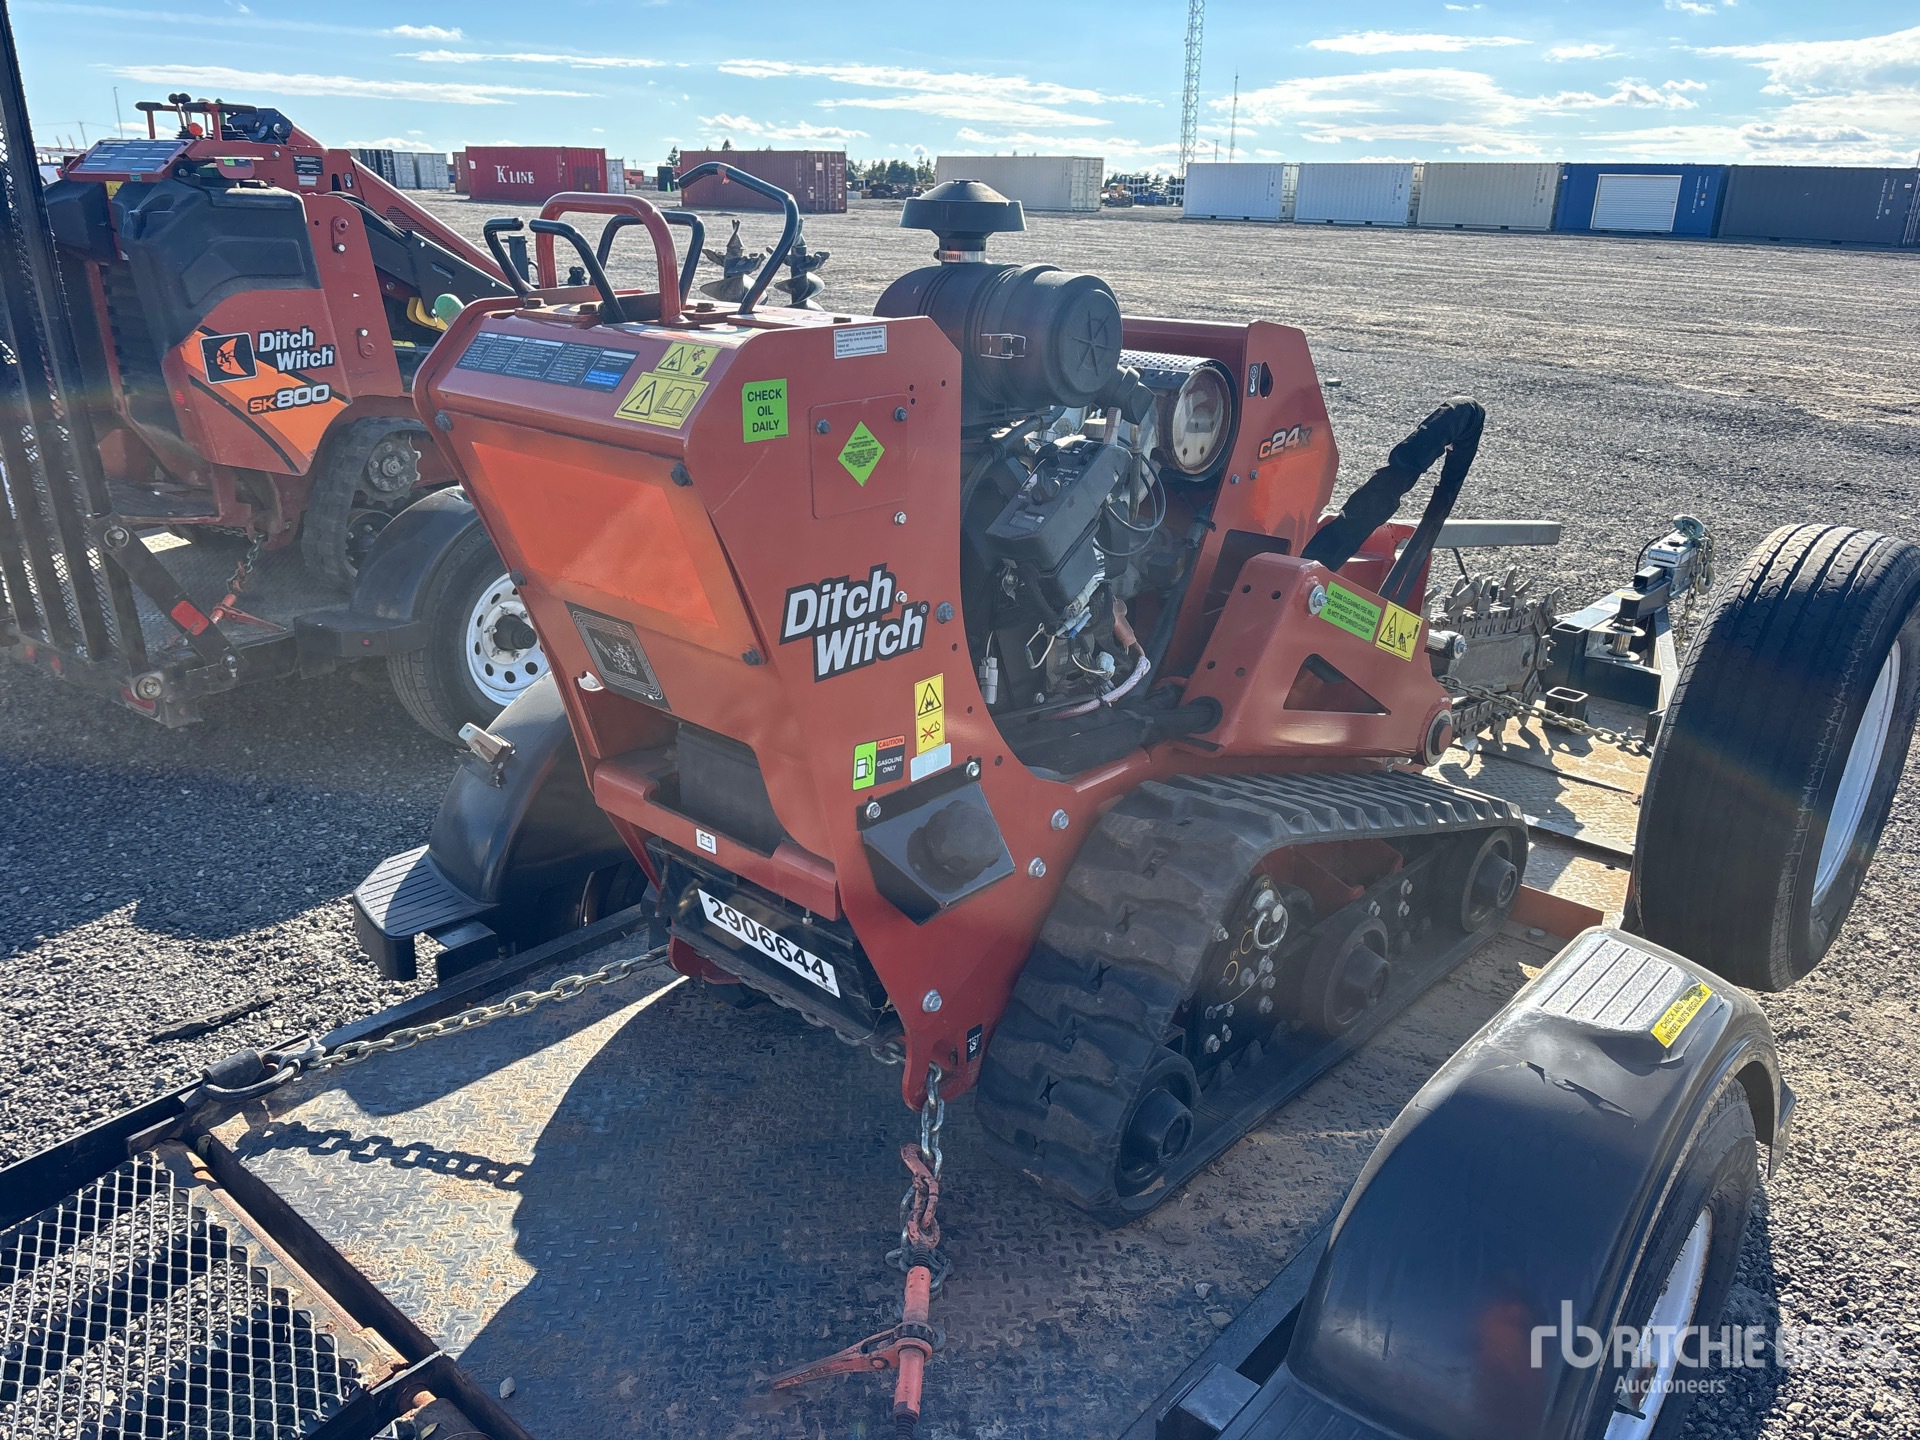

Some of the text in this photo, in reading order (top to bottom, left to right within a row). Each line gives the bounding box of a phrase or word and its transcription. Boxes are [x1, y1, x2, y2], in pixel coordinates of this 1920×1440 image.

[494, 165, 535, 184] K LINE
[260, 328, 314, 352] Ditch
[276, 347, 334, 371] Witch
[250, 384, 330, 412] SK800
[747, 388, 782, 402] CHECK
[757, 405, 774, 417] OIL
[752, 419, 780, 433] DAILY
[784, 570, 893, 638] Ditch
[878, 737, 903, 749] CAUTION
[876, 755, 903, 767] GASOLINE
[882, 764, 897, 773] ONLY
[708, 897, 829, 984] 2906644
[1660, 1011, 1677, 1029] CHECK
[1673, 1002, 1684, 1015] AND
[1664, 1023, 1681, 1041] WHEEL
[1677, 1010, 1691, 1025] NUTS
